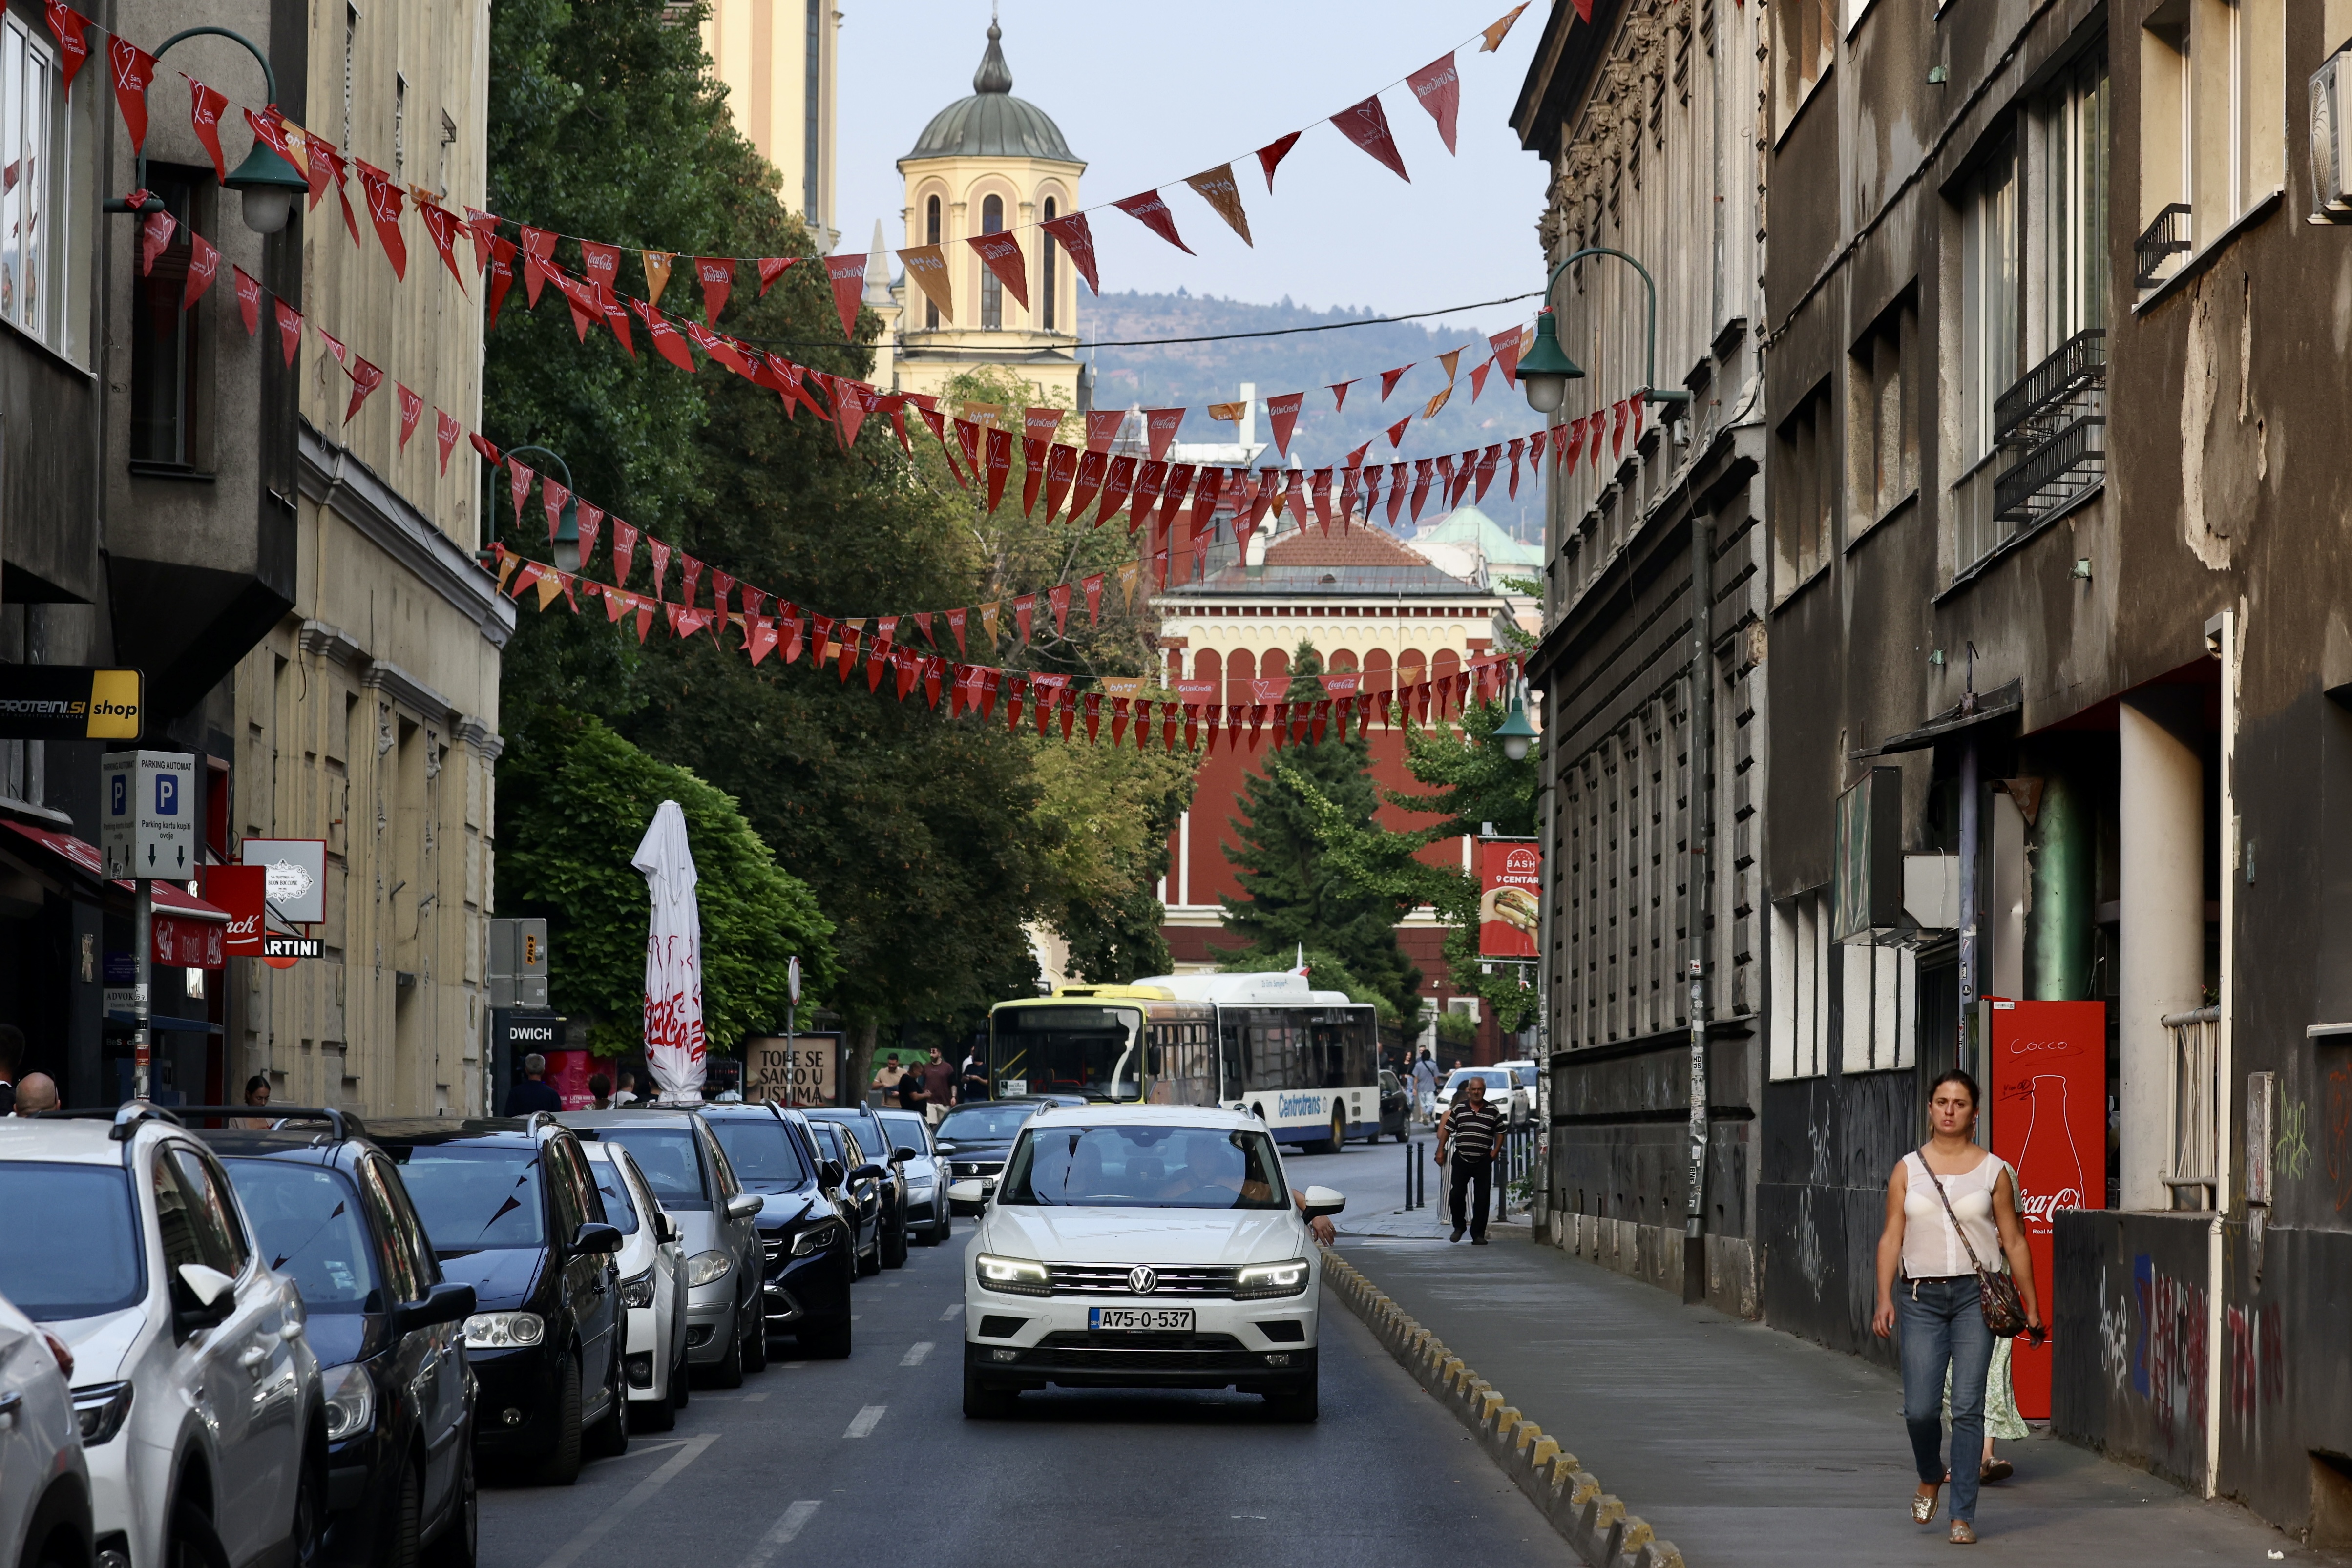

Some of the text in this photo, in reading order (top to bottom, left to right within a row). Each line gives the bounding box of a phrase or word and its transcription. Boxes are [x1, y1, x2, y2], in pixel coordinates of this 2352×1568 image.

[1499, 336, 1520, 350] UniCredit
[1276, 403, 1299, 415] UniCredit
[969, 411, 982, 423] bh
[1033, 418, 1058, 428] UniCredit
[1036, 675, 1065, 687] Coca-Cola
[1328, 678, 1355, 690] Coca-Cola
[1110, 683, 1123, 692] bh
[93, 699, 137, 719] shop
[142, 759, 191, 771] PARKING AUTOMAT
[161, 781, 173, 808] P
[142, 820, 191, 831] Parking kartu kupiti
[160, 832, 173, 840] ovdje
[1507, 860, 1535, 868] BASH
[1503, 876, 1539, 884] CENTAR
[510, 1027, 552, 1040] DWICH
[805, 1051, 823, 1067] SE
[812, 1068, 822, 1085] U
[1279, 1092, 1321, 1118] Centrotrans
